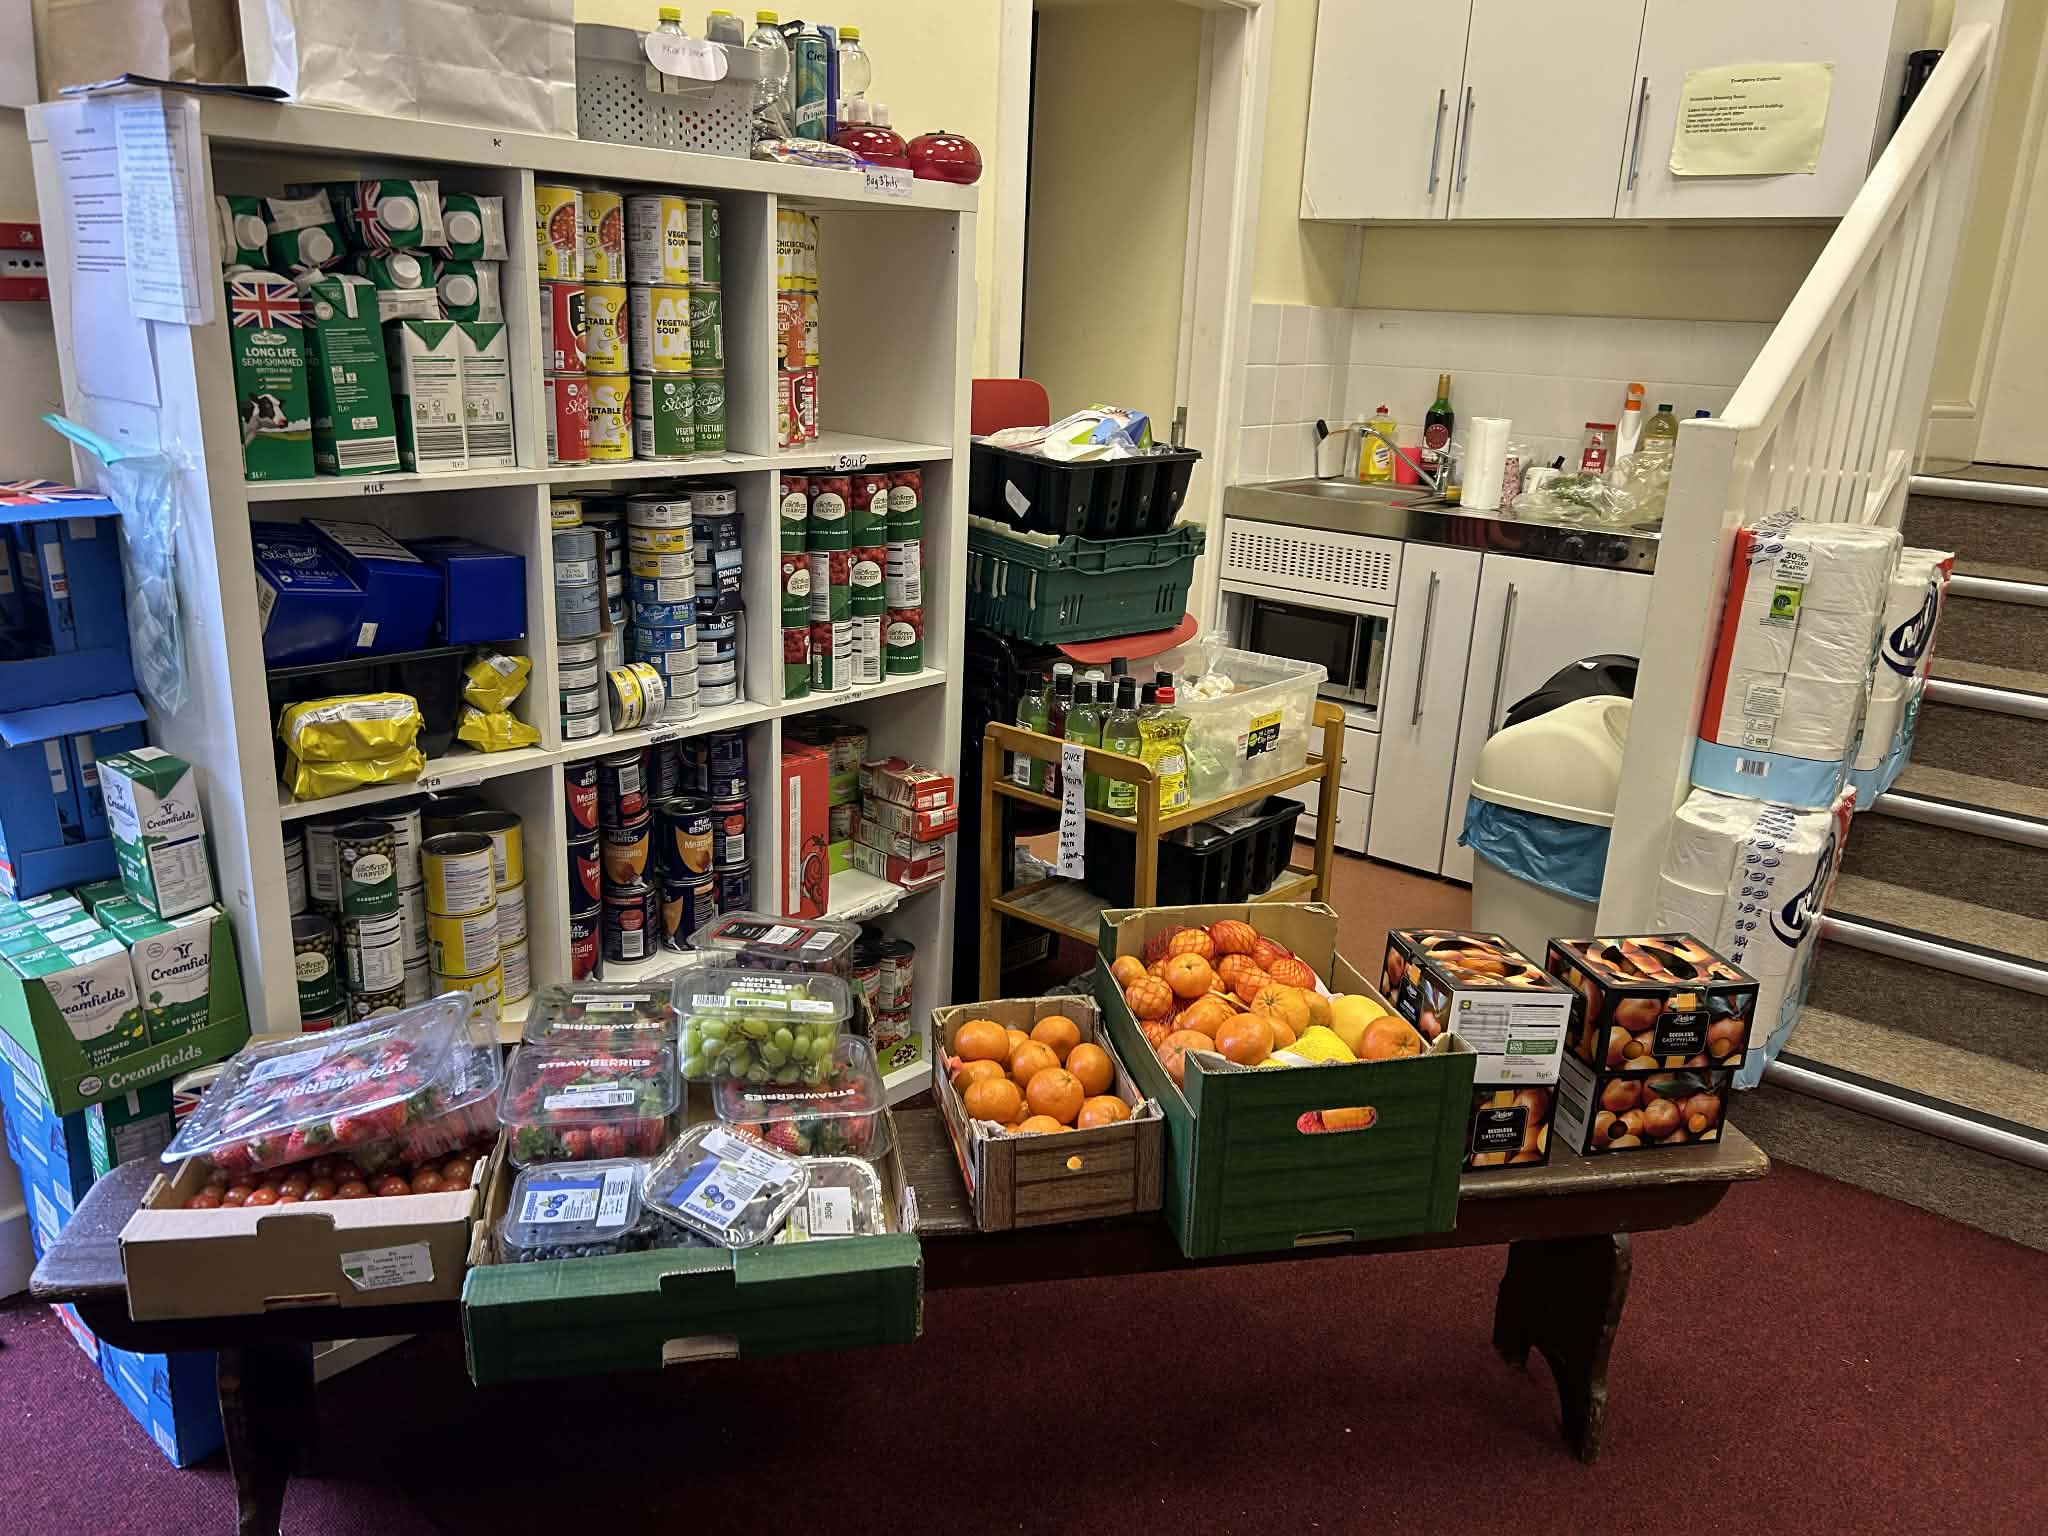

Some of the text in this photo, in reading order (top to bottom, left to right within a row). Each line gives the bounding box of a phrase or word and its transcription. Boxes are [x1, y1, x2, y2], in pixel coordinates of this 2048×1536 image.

[657, 327, 679, 335] SOUP
[692, 339, 710, 349] TABLE
[246, 347, 299, 358] LONG LIFE
[241, 358, 303, 367] SEMI-SKIMMED
[364, 481, 385, 494] MILK
[1785, 551, 1807, 561] 30%
[709, 622, 727, 631] TUNA
[1066, 764, 1073, 772] A
[147, 810, 195, 829] Creamfields
[694, 818, 710, 826] FRAY
[741, 976, 782, 984] WHITE
[731, 981, 793, 990] SEEDLESS
[552, 1023, 660, 1031] STRAWBERRIES
[108, 1045, 204, 1089] Creamfields
[537, 1059, 651, 1069] STRAWBERRIES
[743, 1088, 856, 1101] STRAWBERRIES
